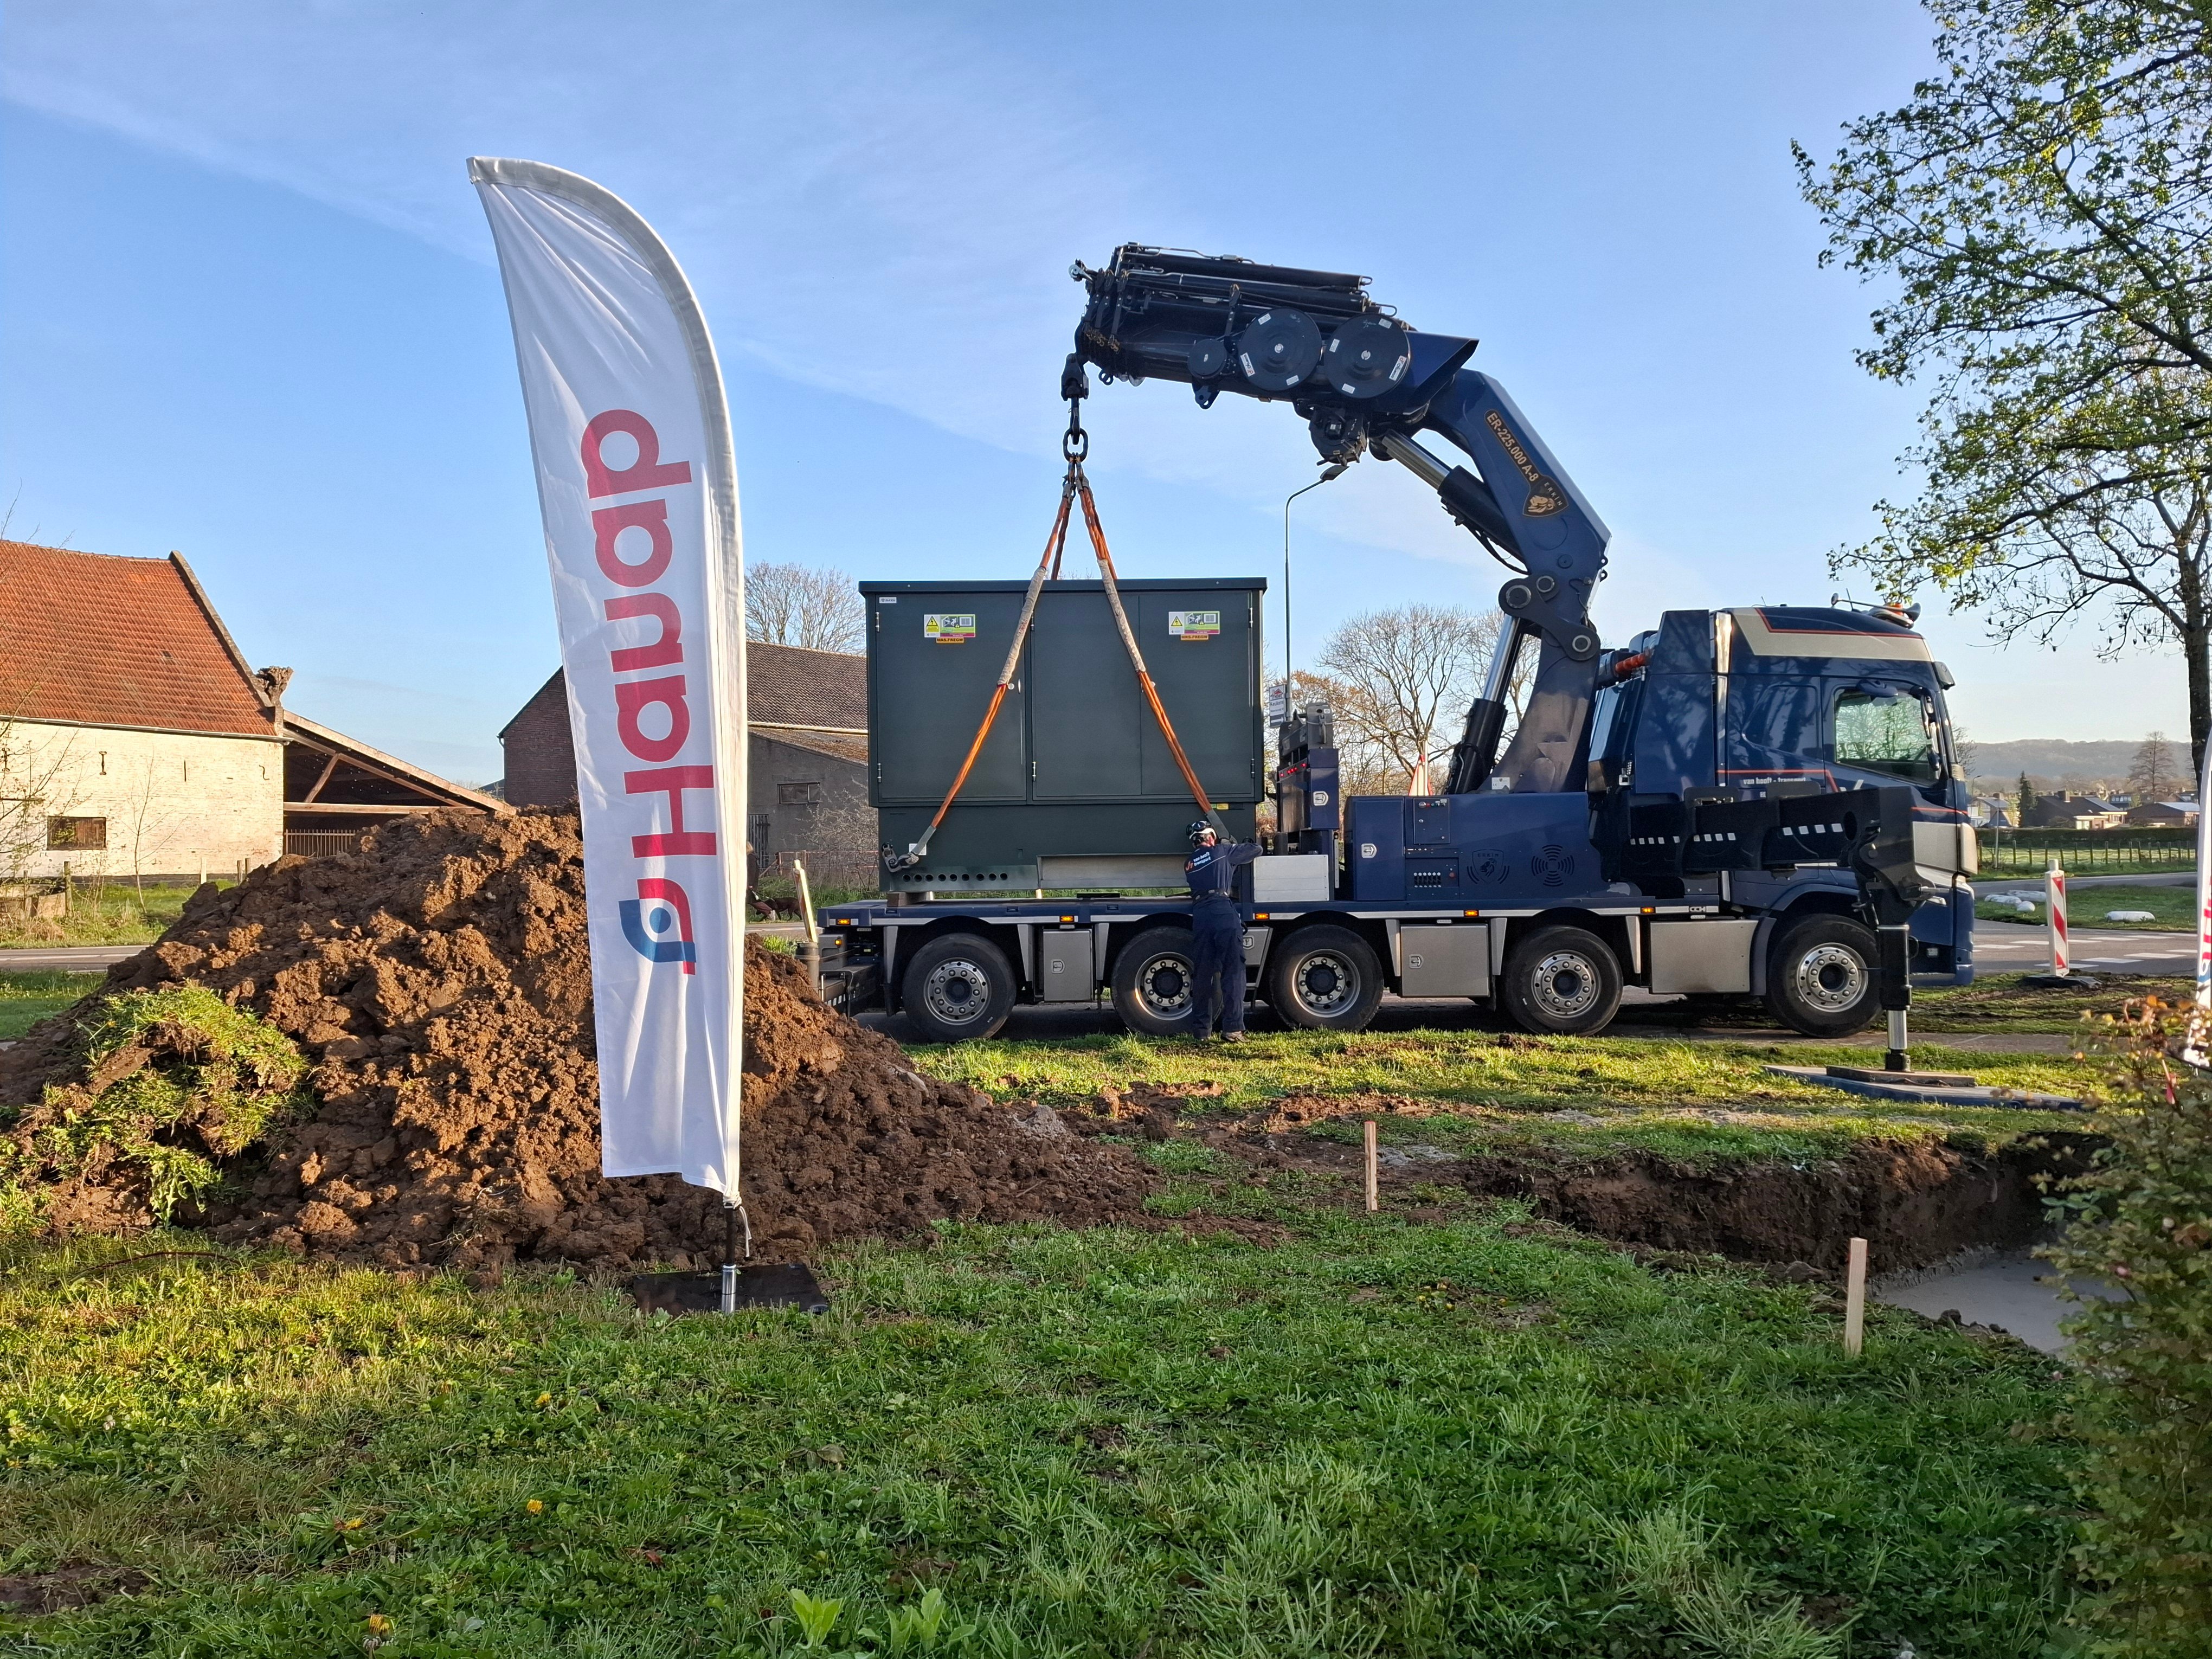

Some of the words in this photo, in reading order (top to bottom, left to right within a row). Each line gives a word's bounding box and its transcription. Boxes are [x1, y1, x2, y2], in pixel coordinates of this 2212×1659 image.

[1487, 413, 1527, 465] ER-225.000
[1521, 465, 1539, 481] A-8
[1544, 482, 1563, 506] ERKIN
